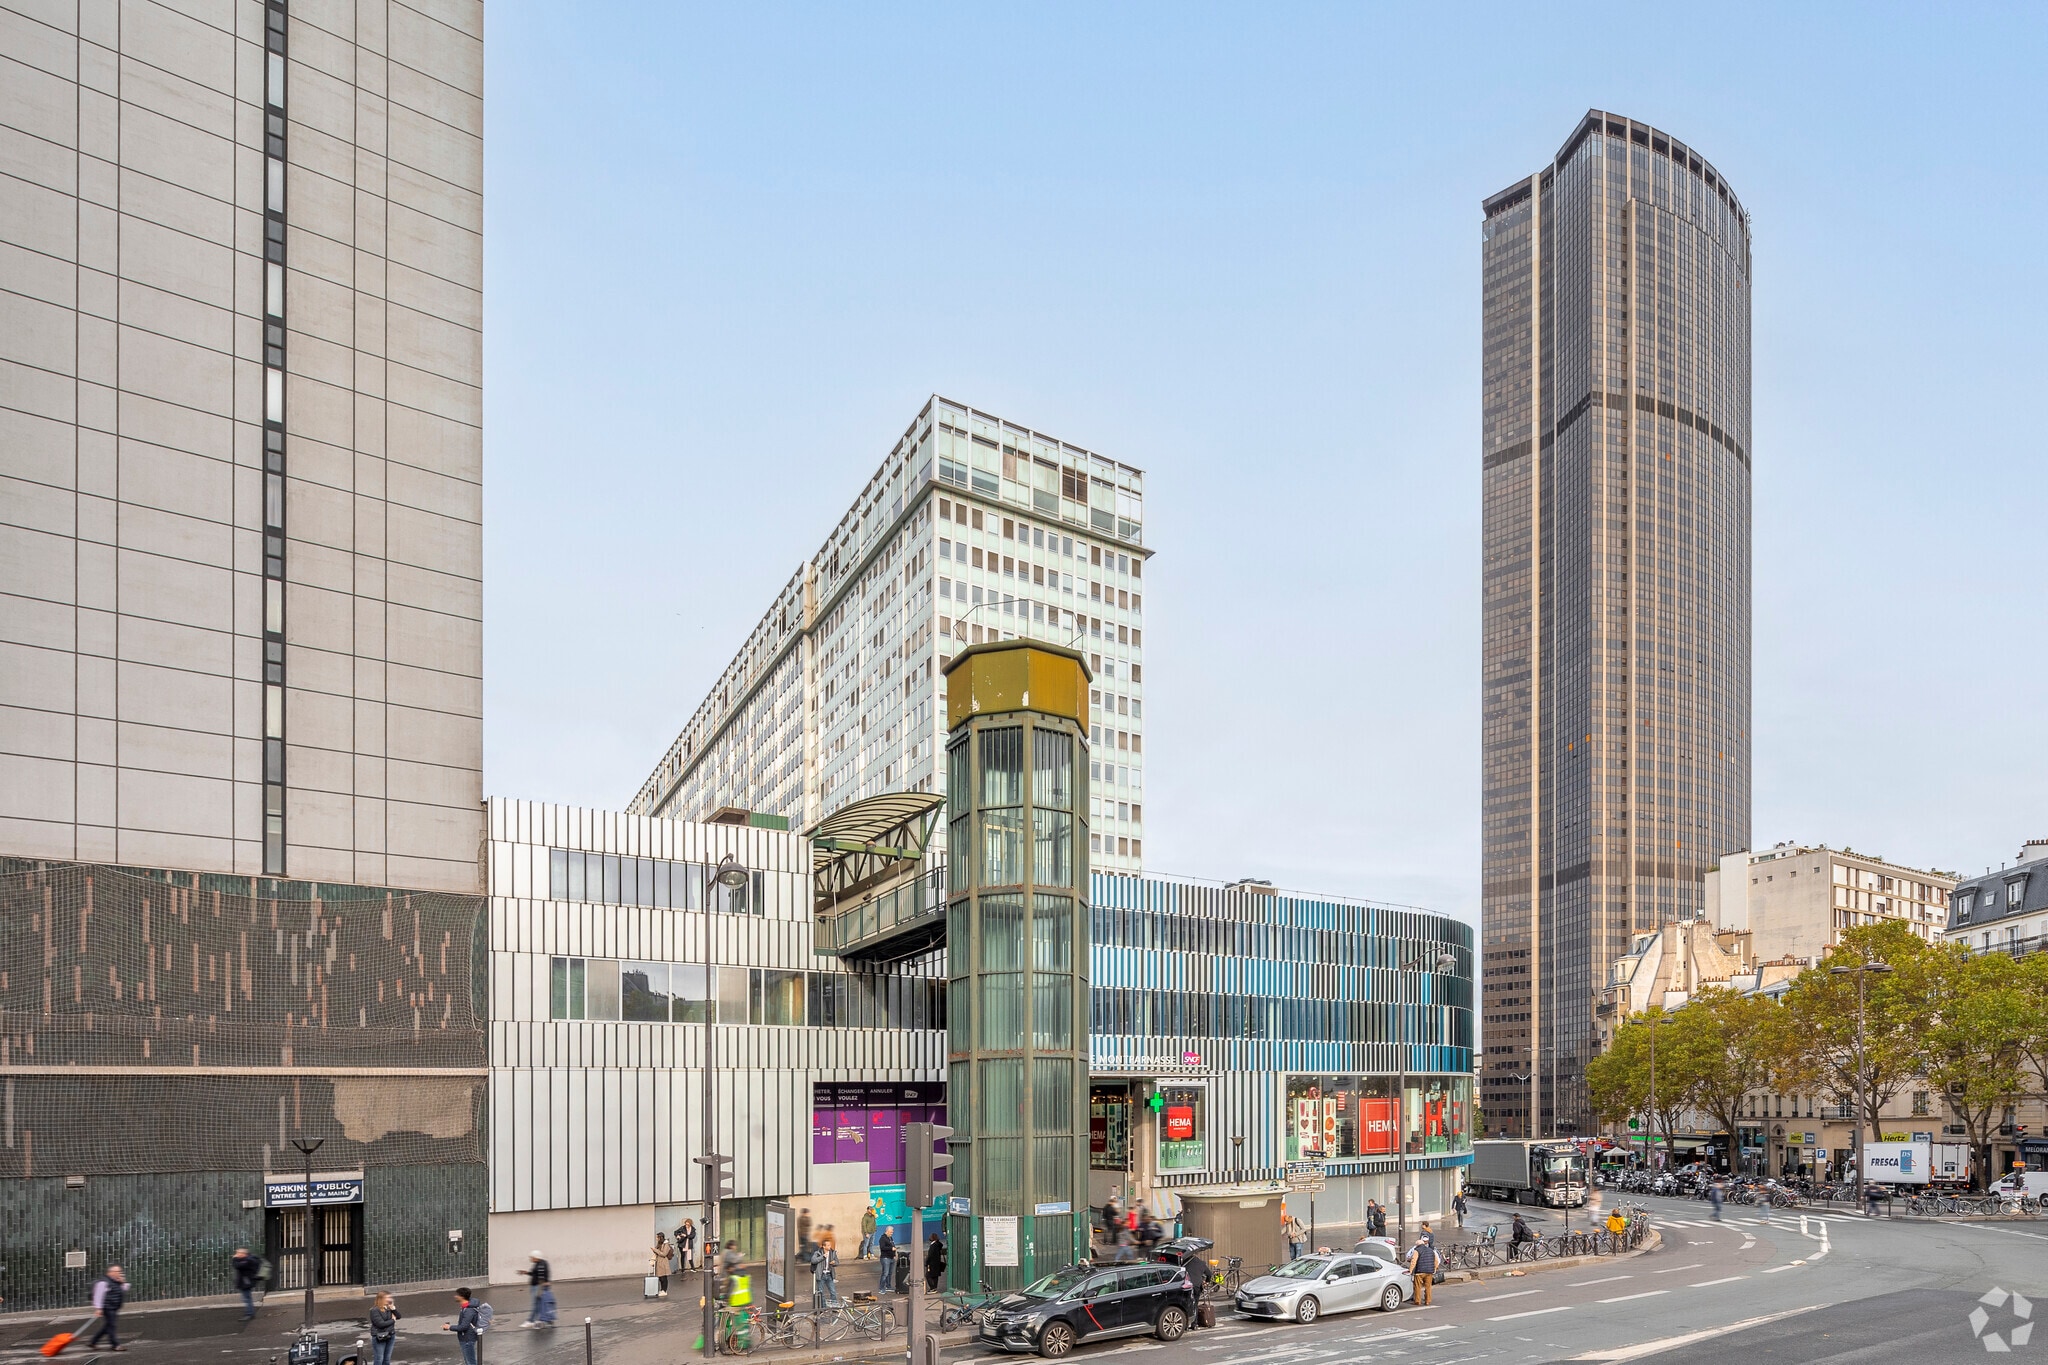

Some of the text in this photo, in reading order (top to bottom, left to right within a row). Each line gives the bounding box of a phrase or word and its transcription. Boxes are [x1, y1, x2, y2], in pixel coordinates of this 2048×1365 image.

[1100, 1055, 1176, 1064] MONTPARNASSE
[1169, 1118, 1192, 1127] HEMA
[1368, 1120, 1398, 1132] HEMA
[1870, 1157, 1899, 1167] FRESCA
[317, 1182, 351, 1190] PUBLIC
